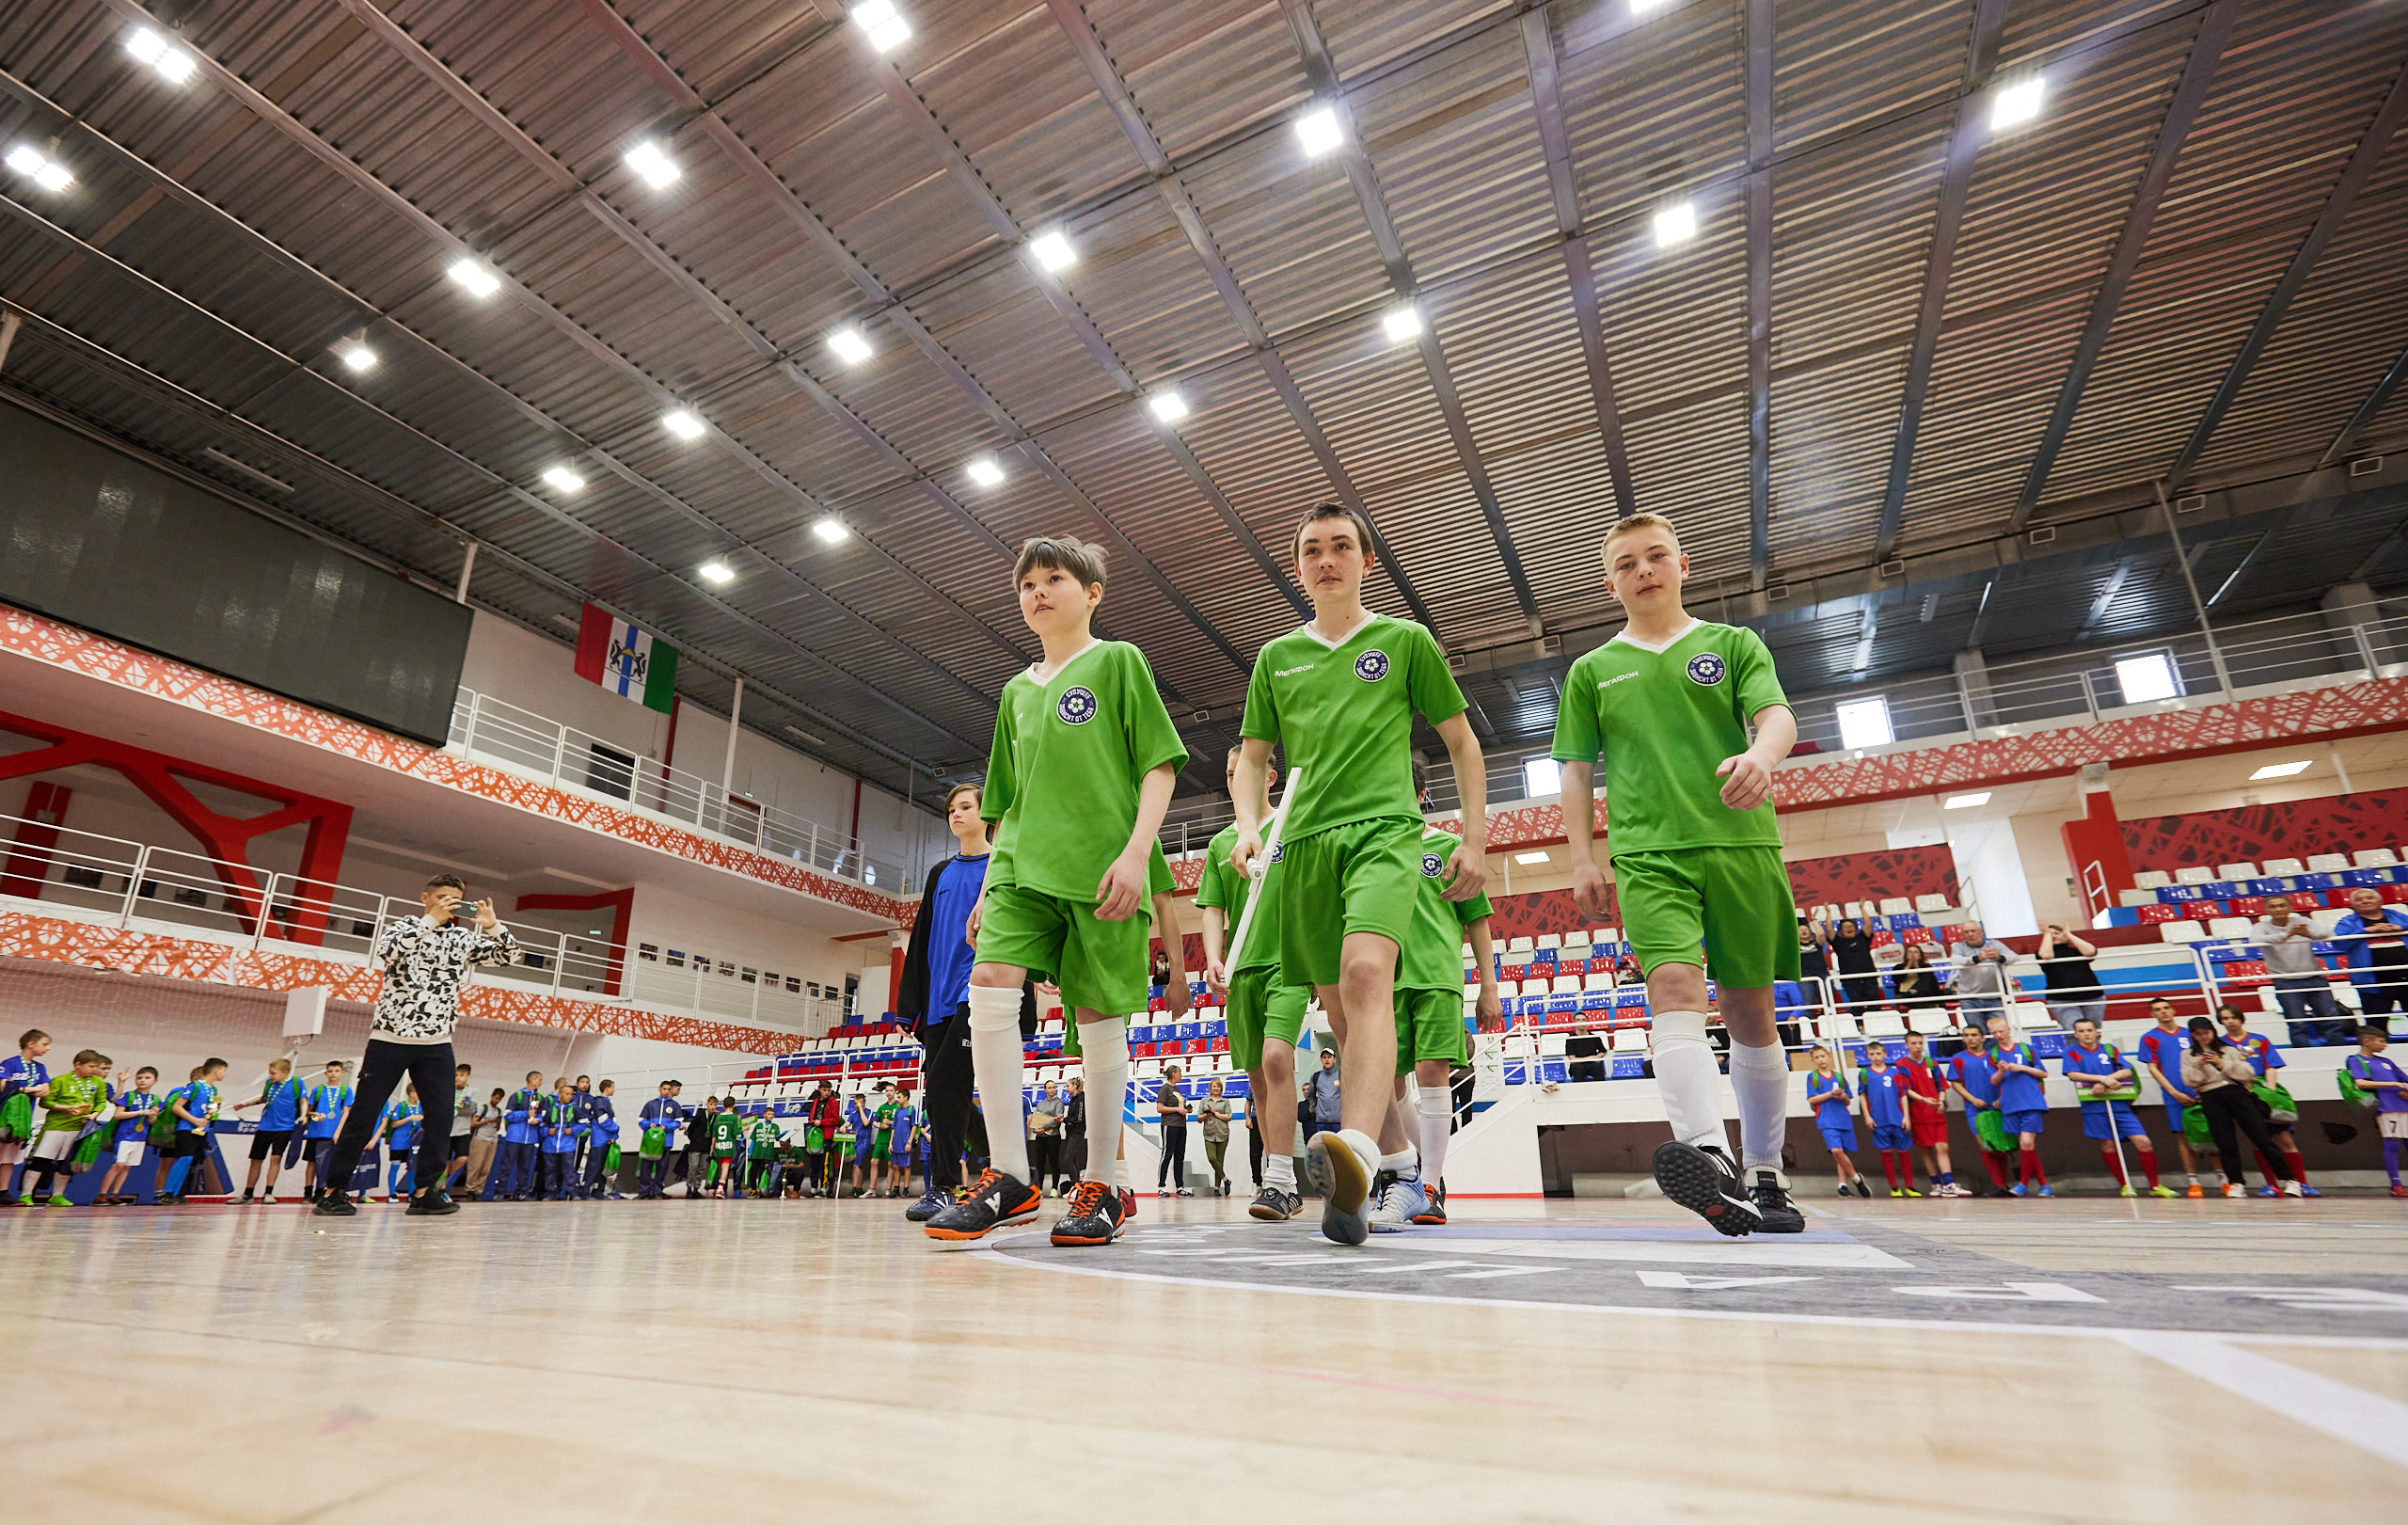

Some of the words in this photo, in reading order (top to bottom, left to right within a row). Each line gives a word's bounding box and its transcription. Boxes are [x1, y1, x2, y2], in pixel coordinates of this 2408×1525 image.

[1275, 663, 1314, 677] МЕГАФОН
[1065, 688, 1092, 700] БУДУЩЕЕ
[2178, 1037, 2191, 1049] 5
[2098, 1053, 2111, 1065] 2
[1882, 1075, 1893, 1088] 3
[718, 1124, 728, 1140] 9
[2389, 1120, 2398, 1134] 7
